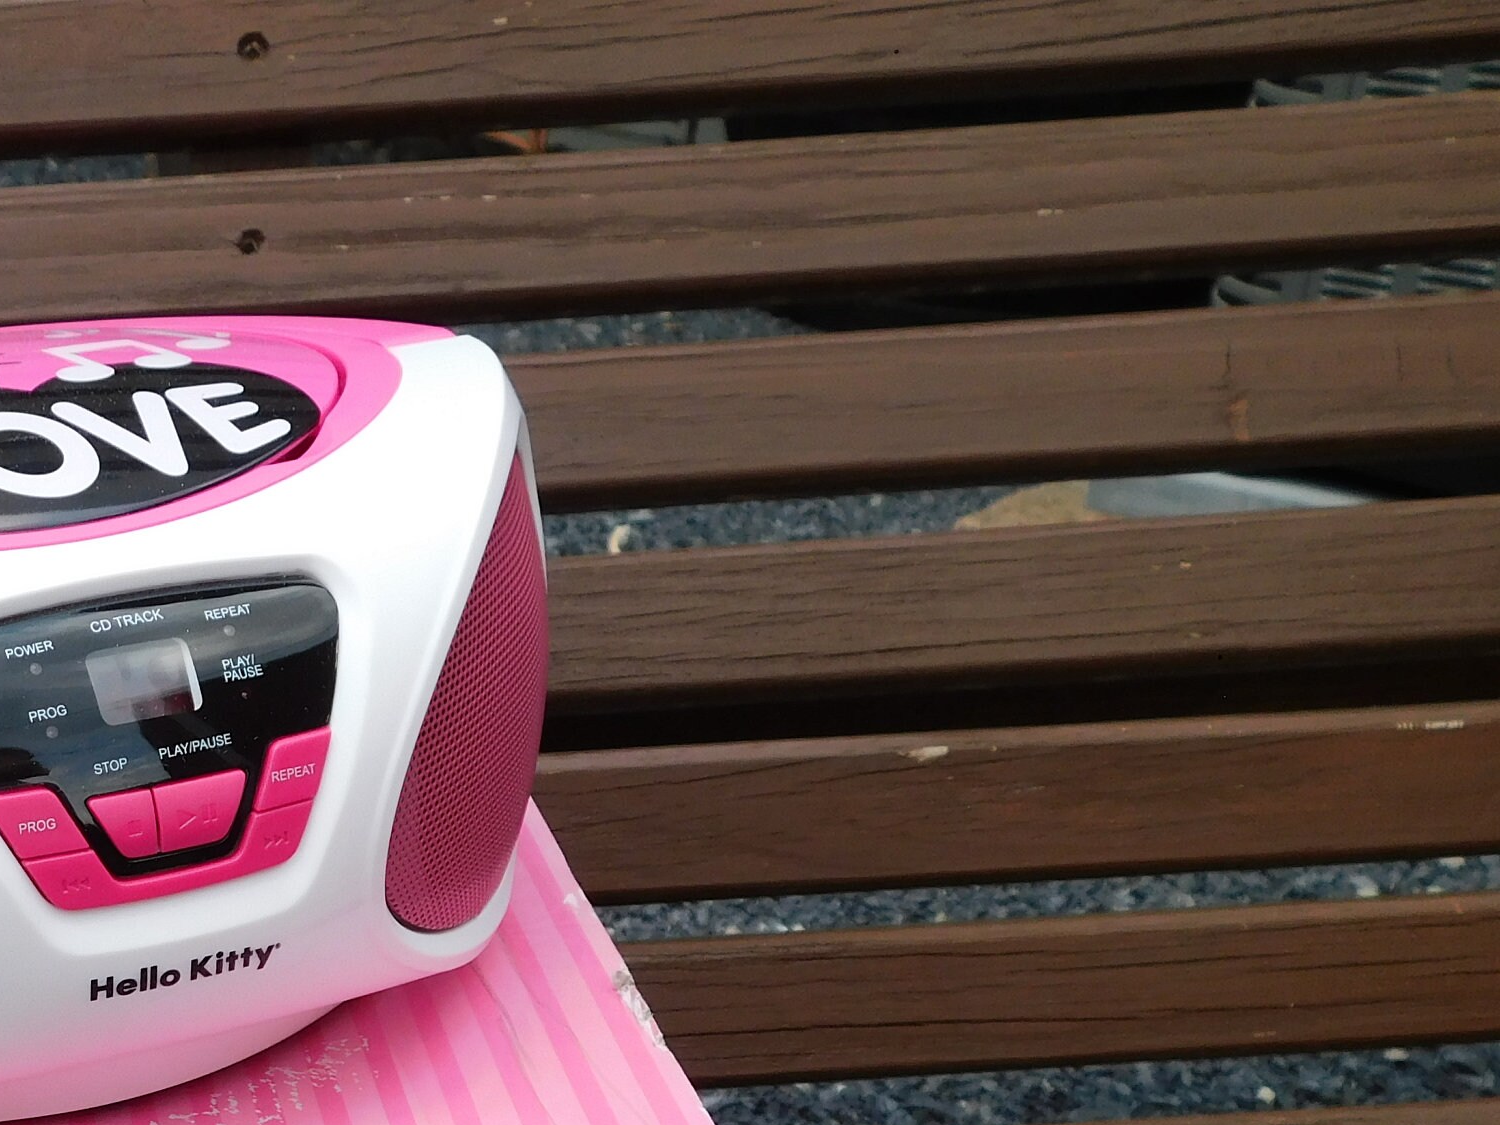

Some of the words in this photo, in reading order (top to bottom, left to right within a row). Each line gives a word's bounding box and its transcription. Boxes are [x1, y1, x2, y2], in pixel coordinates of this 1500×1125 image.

[89, 619, 112, 633] CD
[113, 608, 164, 629] TRACK
[203, 603, 251, 621] REPEAT
[4, 640, 55, 660] POWER
[221, 653, 255, 671] PLAY/
[223, 664, 264, 683] PAUSE
[28, 704, 68, 724] PROG
[158, 733, 233, 760] PLAY/PAUSE
[93, 757, 129, 775] STOP
[271, 763, 316, 783] REPEAT
[18, 817, 57, 835] PROG
[90, 965, 181, 1002] Hello
[190, 945, 275, 981] Kitty
